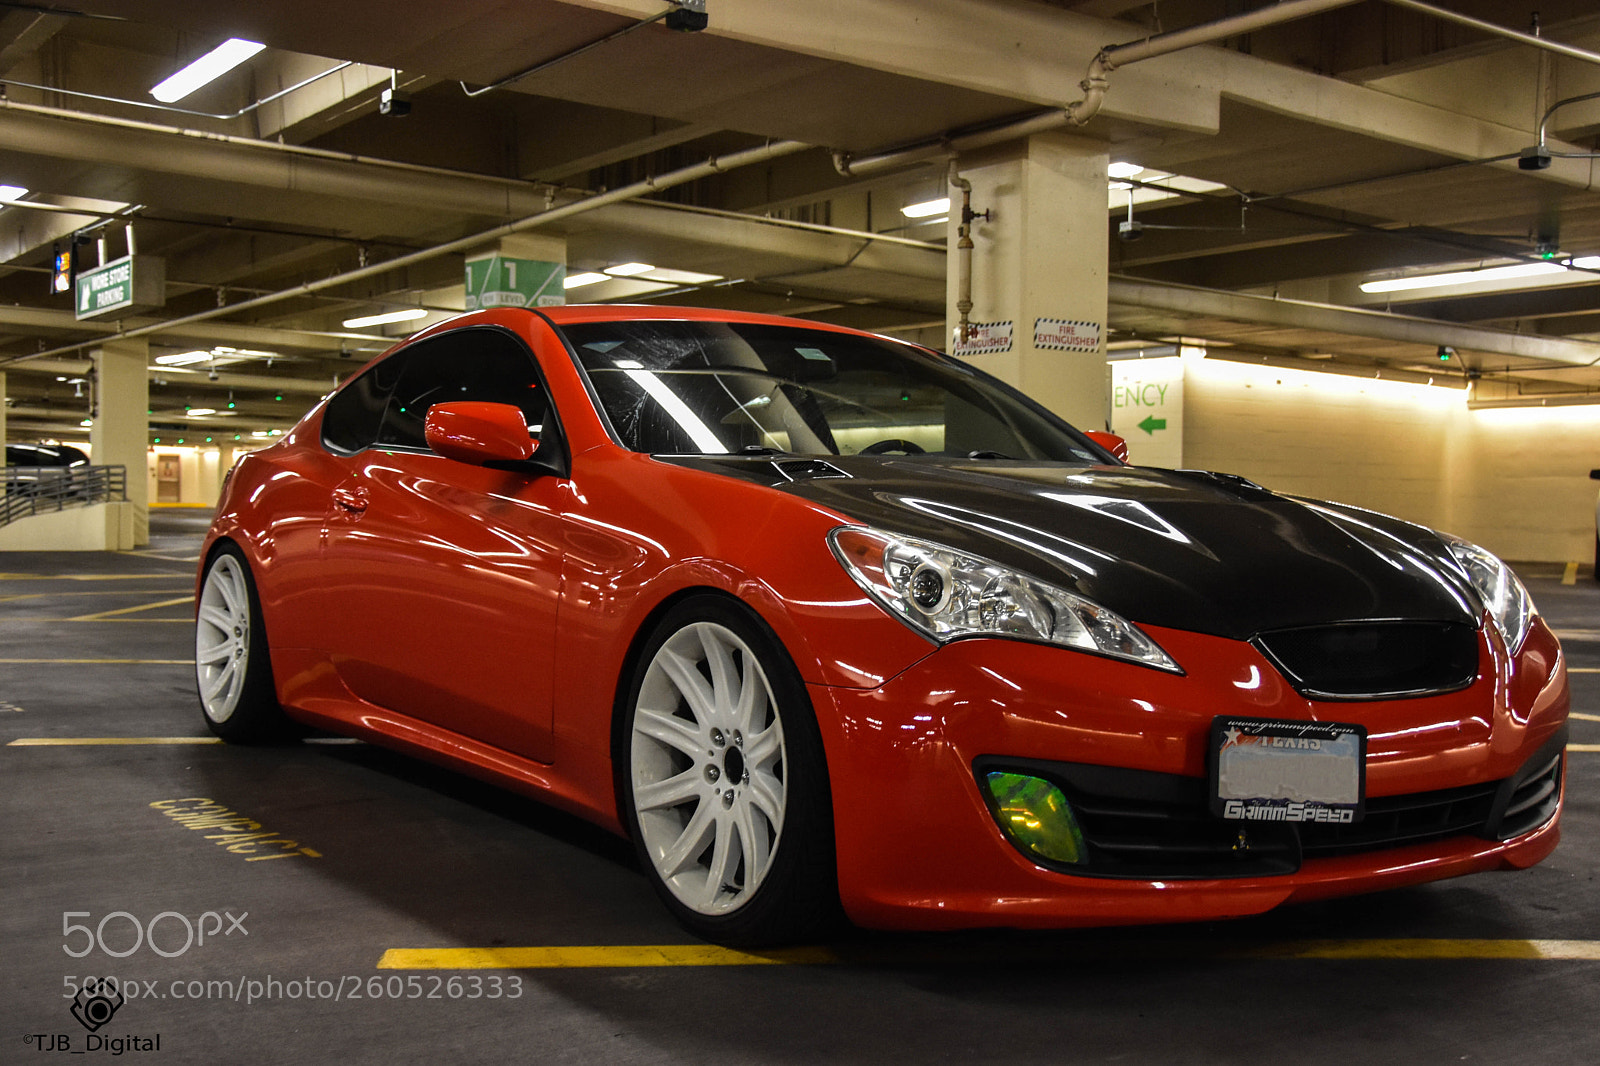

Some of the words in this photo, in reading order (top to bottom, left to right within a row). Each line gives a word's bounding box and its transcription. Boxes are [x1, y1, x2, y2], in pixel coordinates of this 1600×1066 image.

[109, 264, 130, 286] STORE
[504, 261, 516, 289] 1
[97, 285, 124, 308] PARKING
[499, 294, 524, 305] LEVEL
[1037, 333, 1096, 347] EXTINGUISHER
[1059, 325, 1076, 336] FIRE
[1114, 383, 1168, 408] ENCY
[1260, 736, 1322, 751] TEXAS
[149, 797, 323, 862] COMPACT
